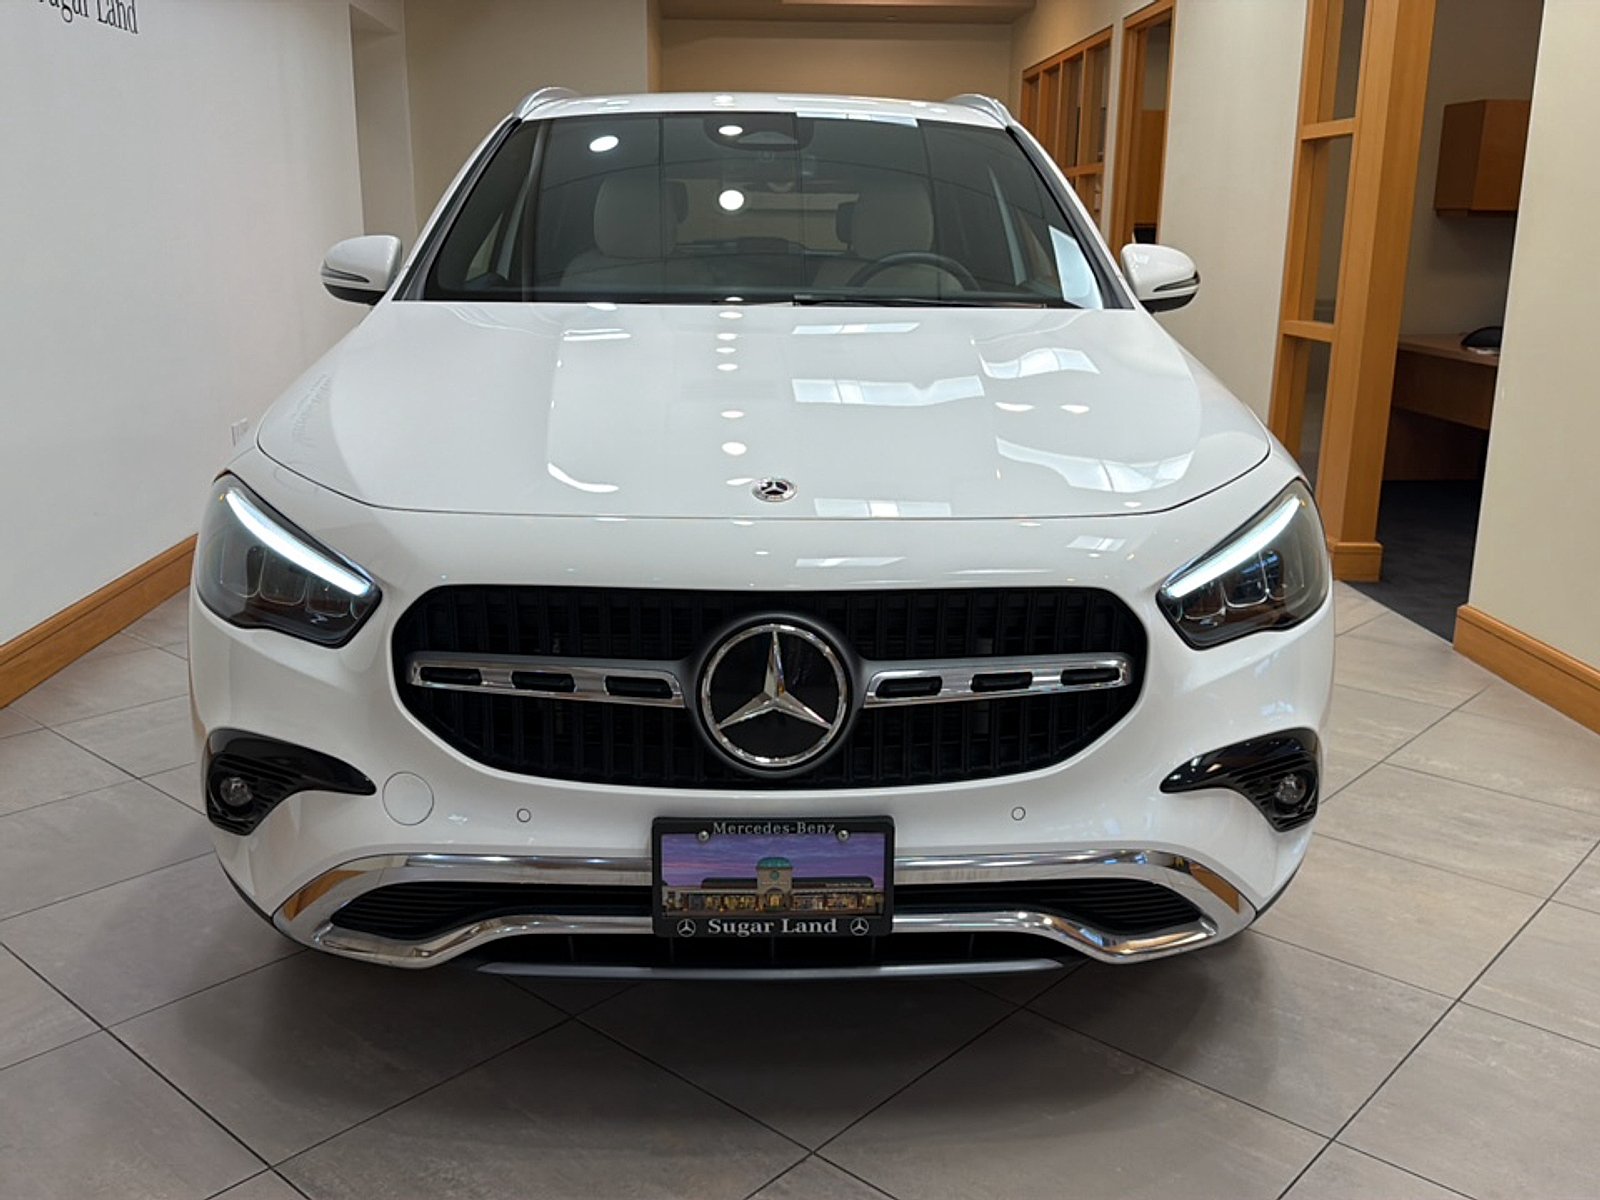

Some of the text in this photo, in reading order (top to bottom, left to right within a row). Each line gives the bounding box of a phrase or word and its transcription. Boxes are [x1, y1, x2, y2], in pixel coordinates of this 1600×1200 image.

[713, 822, 835, 834] Mercedes-Benz
[708, 918, 838, 938] Sugar Land
